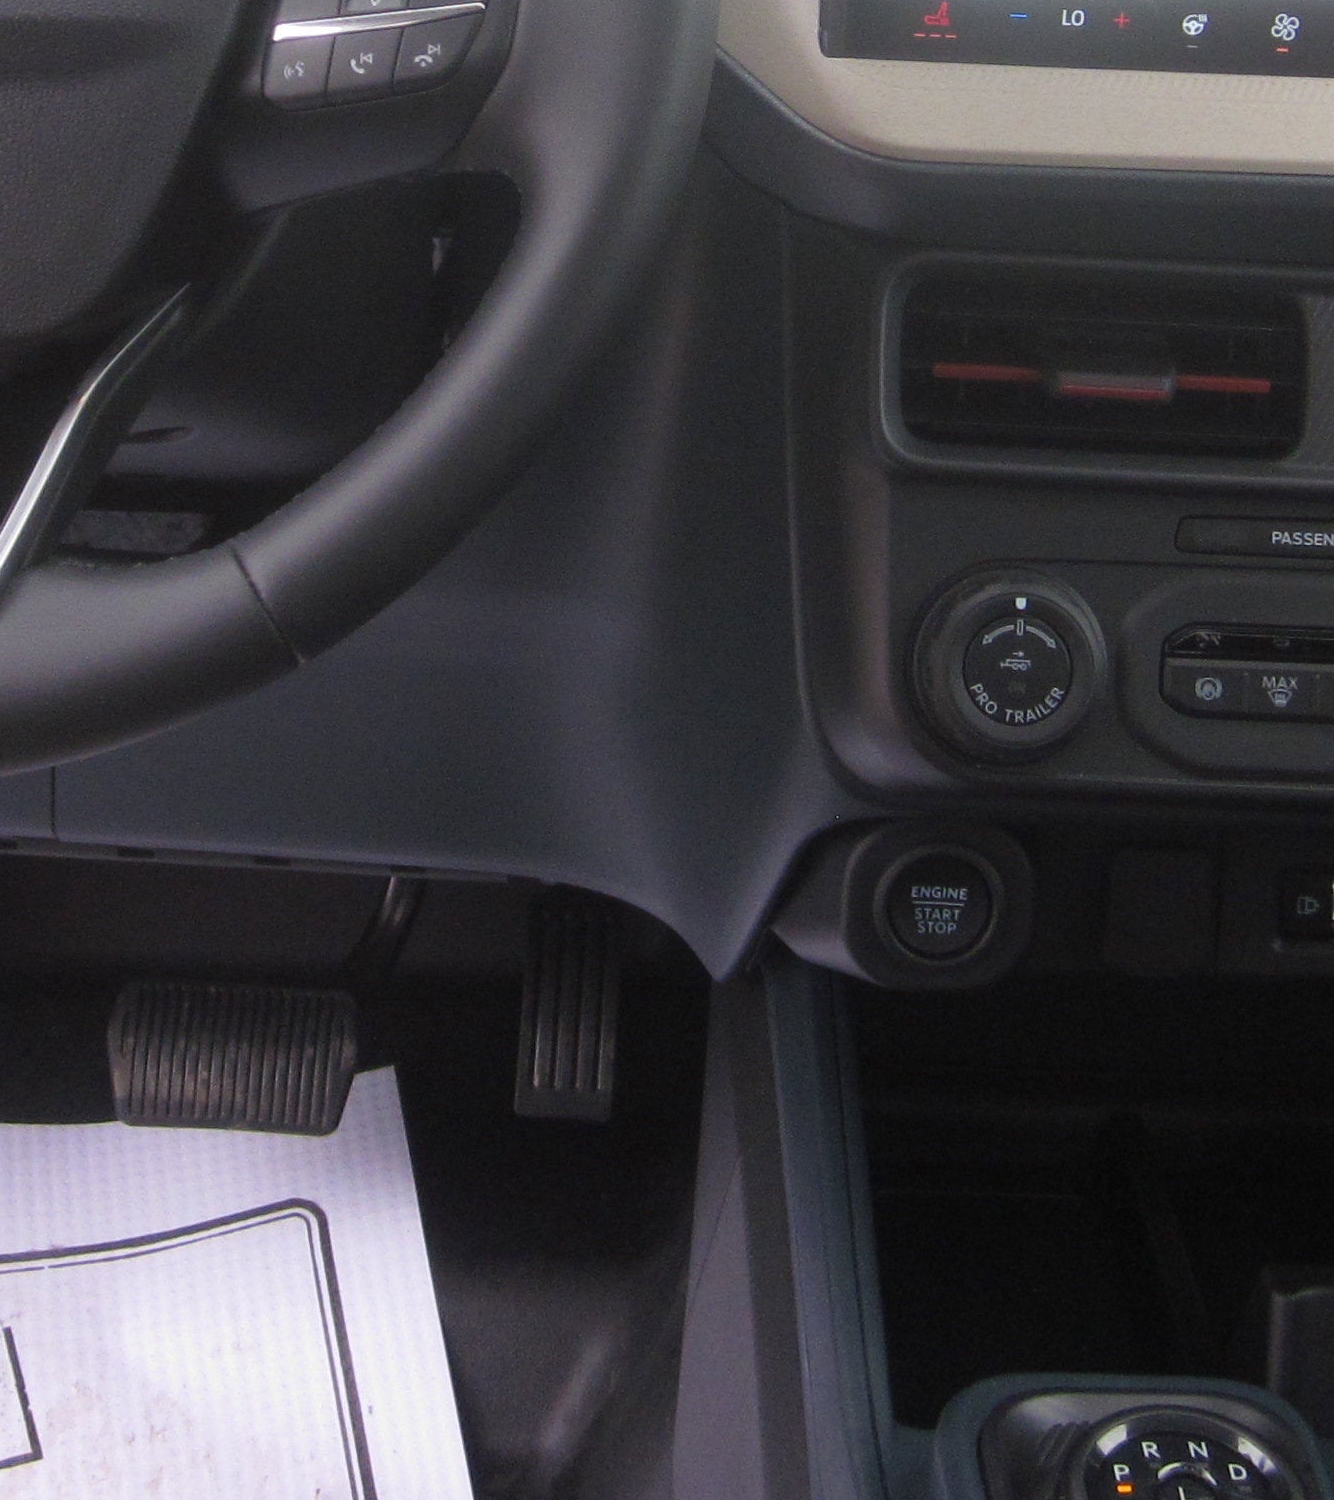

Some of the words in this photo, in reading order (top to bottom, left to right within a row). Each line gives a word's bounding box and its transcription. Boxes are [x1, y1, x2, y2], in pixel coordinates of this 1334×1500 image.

[1062, 9, 1085, 27] LO
[1262, 675, 1298, 690] MAX
[970, 684, 997, 714] PRO
[1005, 687, 1065, 723] TRAILER
[911, 886, 968, 900] ENGINE
[914, 908, 960, 920] START
[917, 921, 957, 934] STOP
[1113, 1464, 1130, 1481] P
[1141, 1441, 1161, 1459] R
[1188, 1441, 1209, 1459] N
[1228, 1463, 1247, 1481] D
